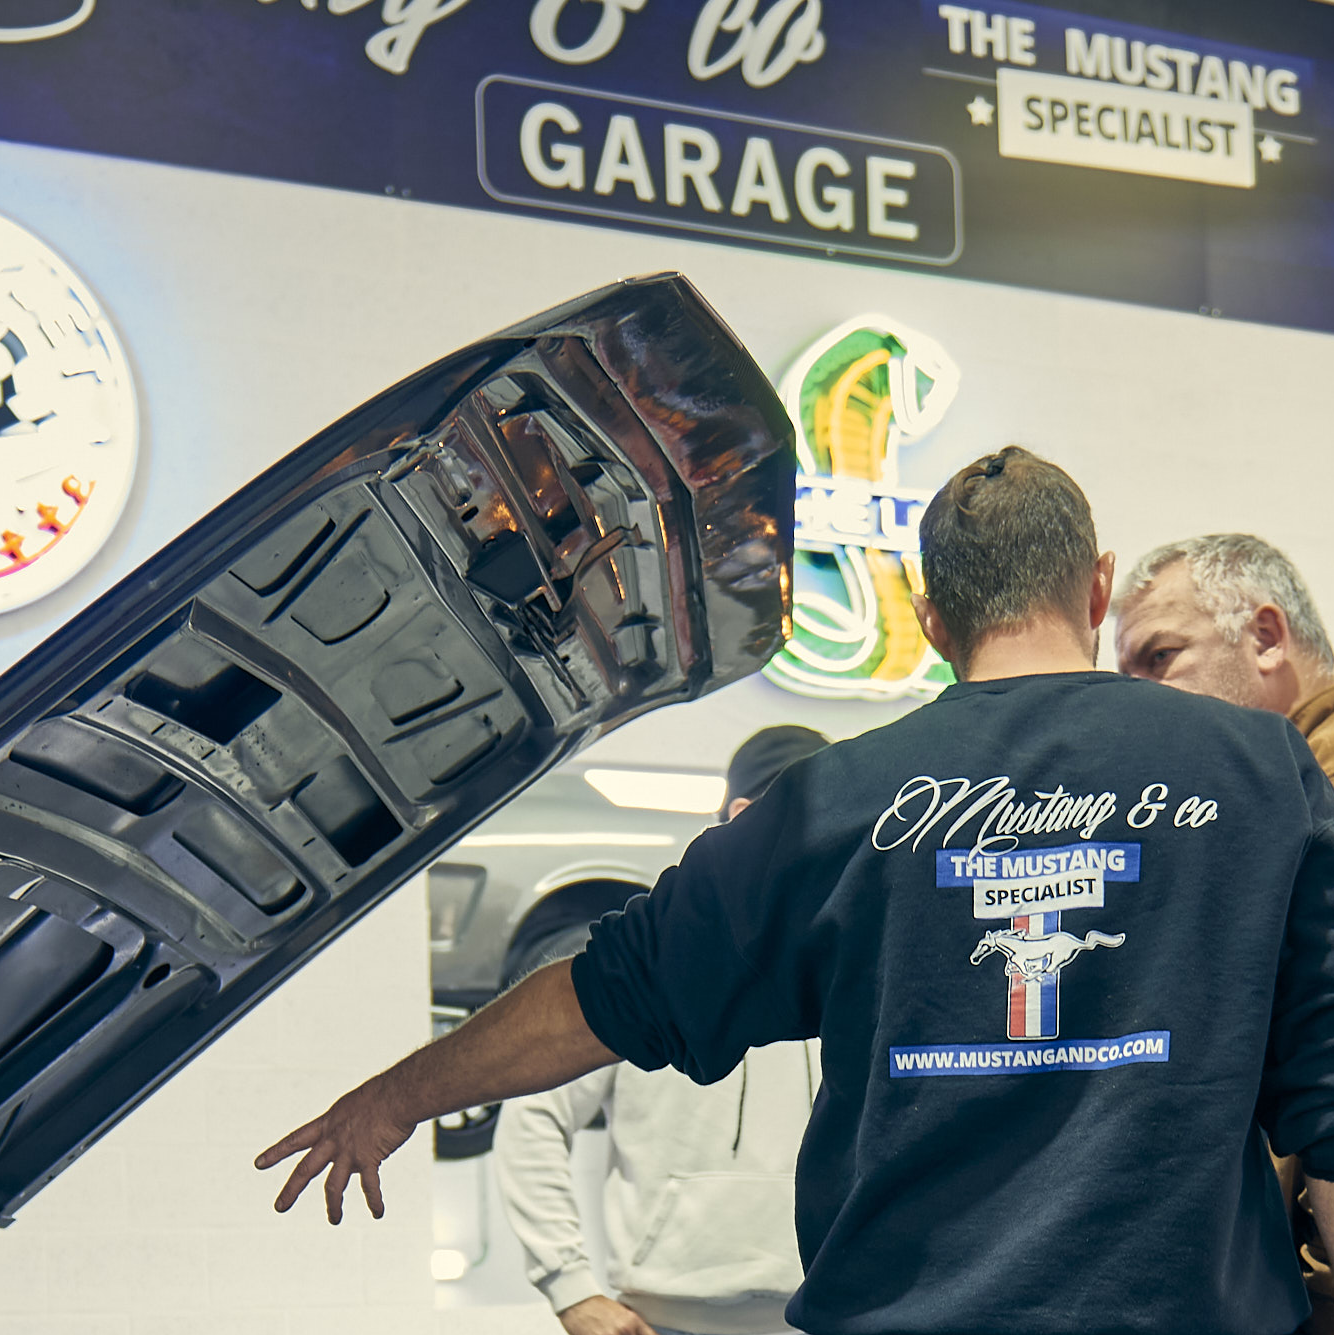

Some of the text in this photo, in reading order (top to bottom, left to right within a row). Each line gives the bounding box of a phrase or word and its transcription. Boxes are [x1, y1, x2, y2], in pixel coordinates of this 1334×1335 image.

[938, 4, 1302, 117] THE MUSTANG
[1023, 96, 1238, 158] SPECIALIST
[519, 101, 919, 241] GARAGE
[870, 774, 1220, 866] Mustang & co
[950, 847, 1127, 879] THE MUSTANG
[984, 877, 1098, 907] SPECIALIST
[894, 1037, 1165, 1072] WWW.MUSTANGANDCO.COM
